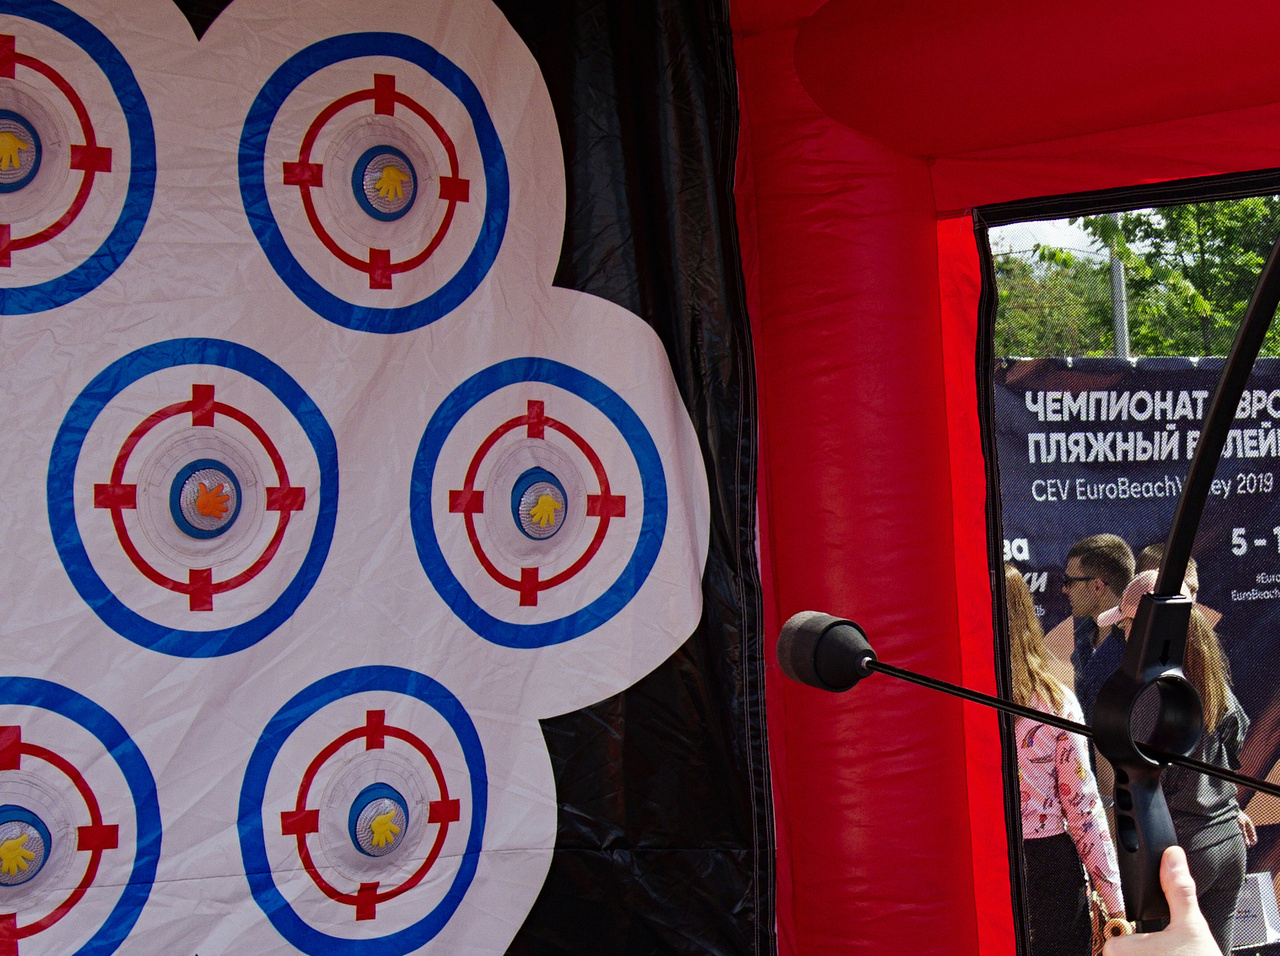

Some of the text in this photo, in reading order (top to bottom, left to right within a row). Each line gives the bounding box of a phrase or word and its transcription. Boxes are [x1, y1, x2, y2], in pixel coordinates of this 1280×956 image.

[1025, 390, 1209, 422] ЧЕМПИОНАТ
[1027, 423, 1181, 464] ПЛЯЖНЫЙ
[1031, 478, 1070, 502] CEV
[1236, 472, 1274, 494] 2019
[1231, 527, 1248, 556] 5
